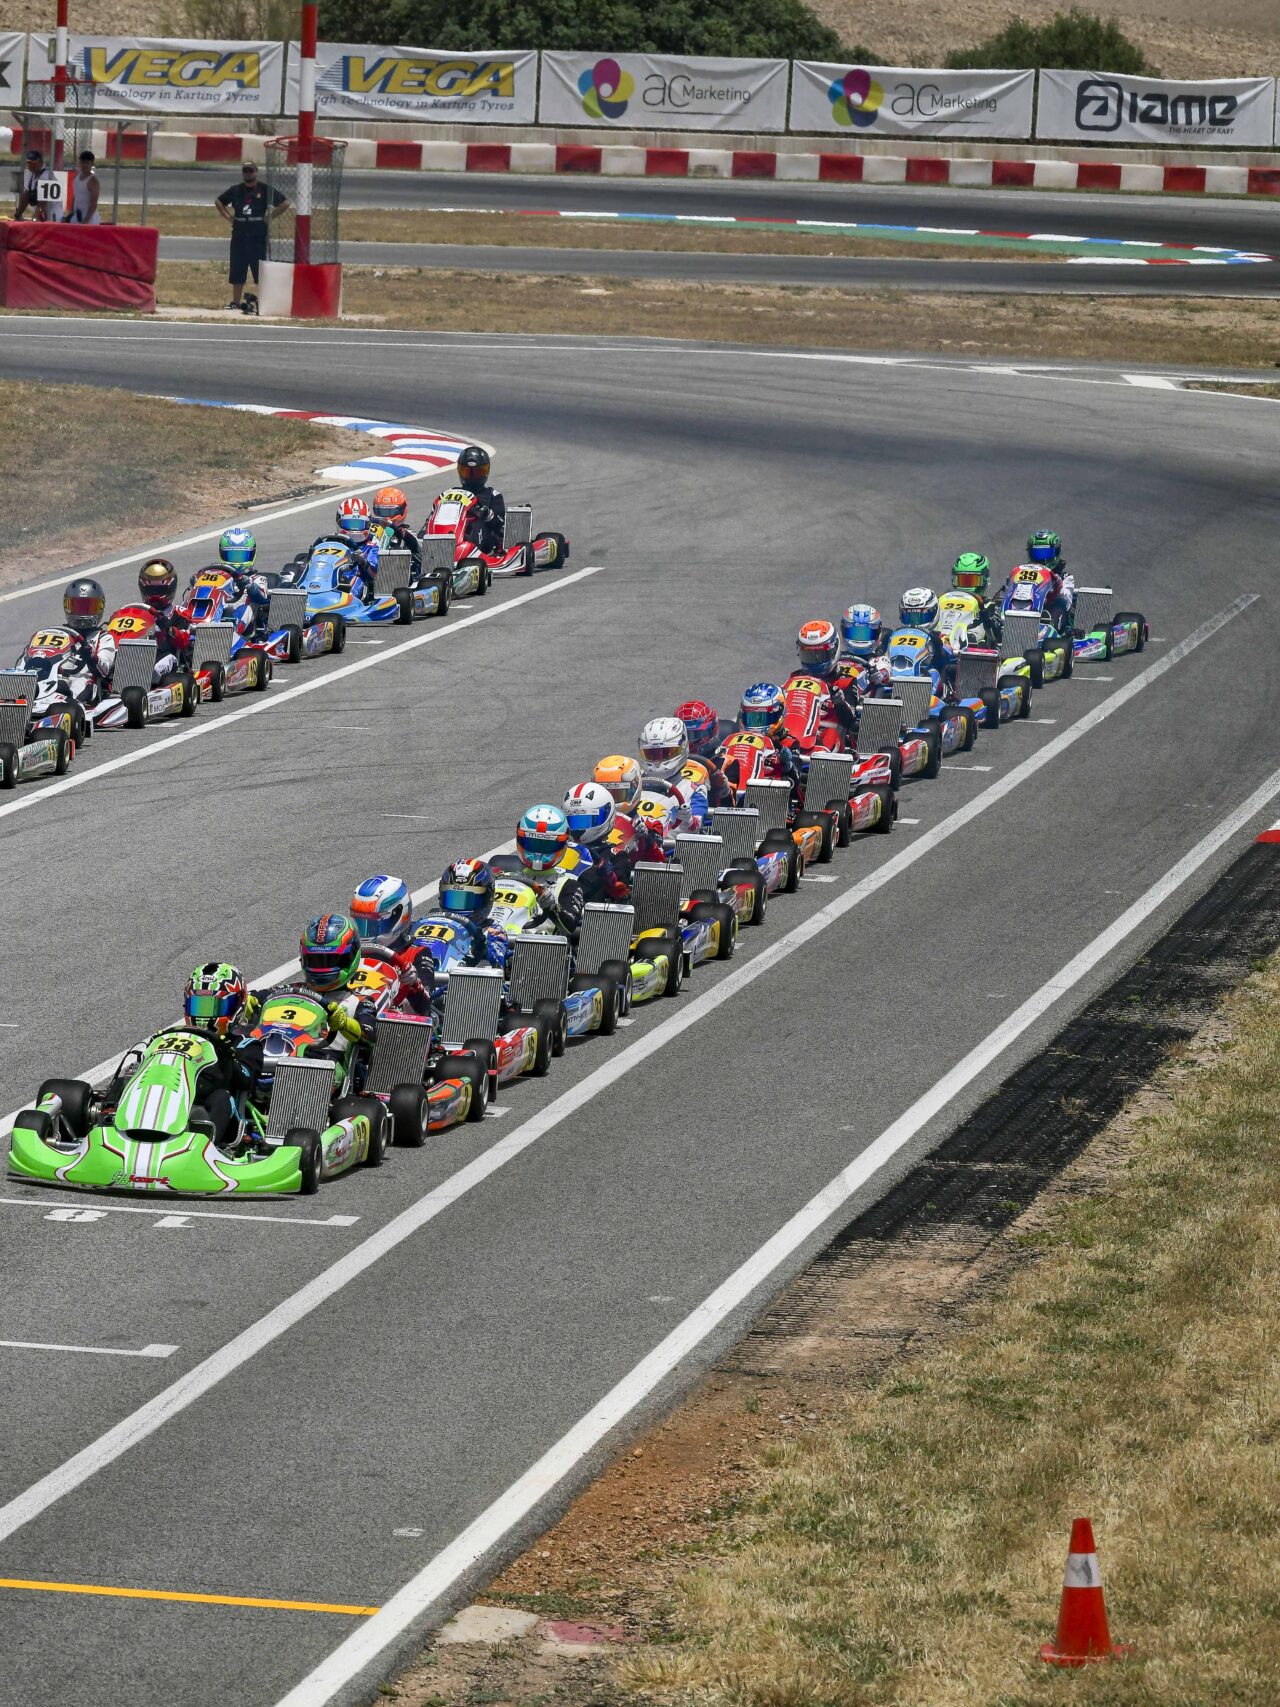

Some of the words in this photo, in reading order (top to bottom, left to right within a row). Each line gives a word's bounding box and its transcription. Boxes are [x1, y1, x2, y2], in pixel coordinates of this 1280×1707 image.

[83, 46, 260, 88] VEGA
[342, 55, 514, 97] VEGA
[174, 88, 221, 102] Karting
[224, 91, 260, 103] Tyres
[682, 83, 751, 104] Marketing
[340, 95, 410, 109] Technology
[430, 99, 476, 111] Karting
[480, 100, 514, 111] Tyres
[930, 93, 998, 113] Marketing
[40, 182, 61, 200] 10
[201, 573, 219, 581] 36
[1019, 570, 1038, 582] 39
[944, 602, 965, 610] 32
[117, 617, 135, 629] 19
[37, 635, 65, 647] 15
[897, 637, 919, 646] 25
[796, 680, 814, 690] 12
[737, 735, 756, 744] 14
[418, 925, 449, 939] 31
[280, 1009, 297, 1020] 3
[157, 1037, 194, 1052] 33
